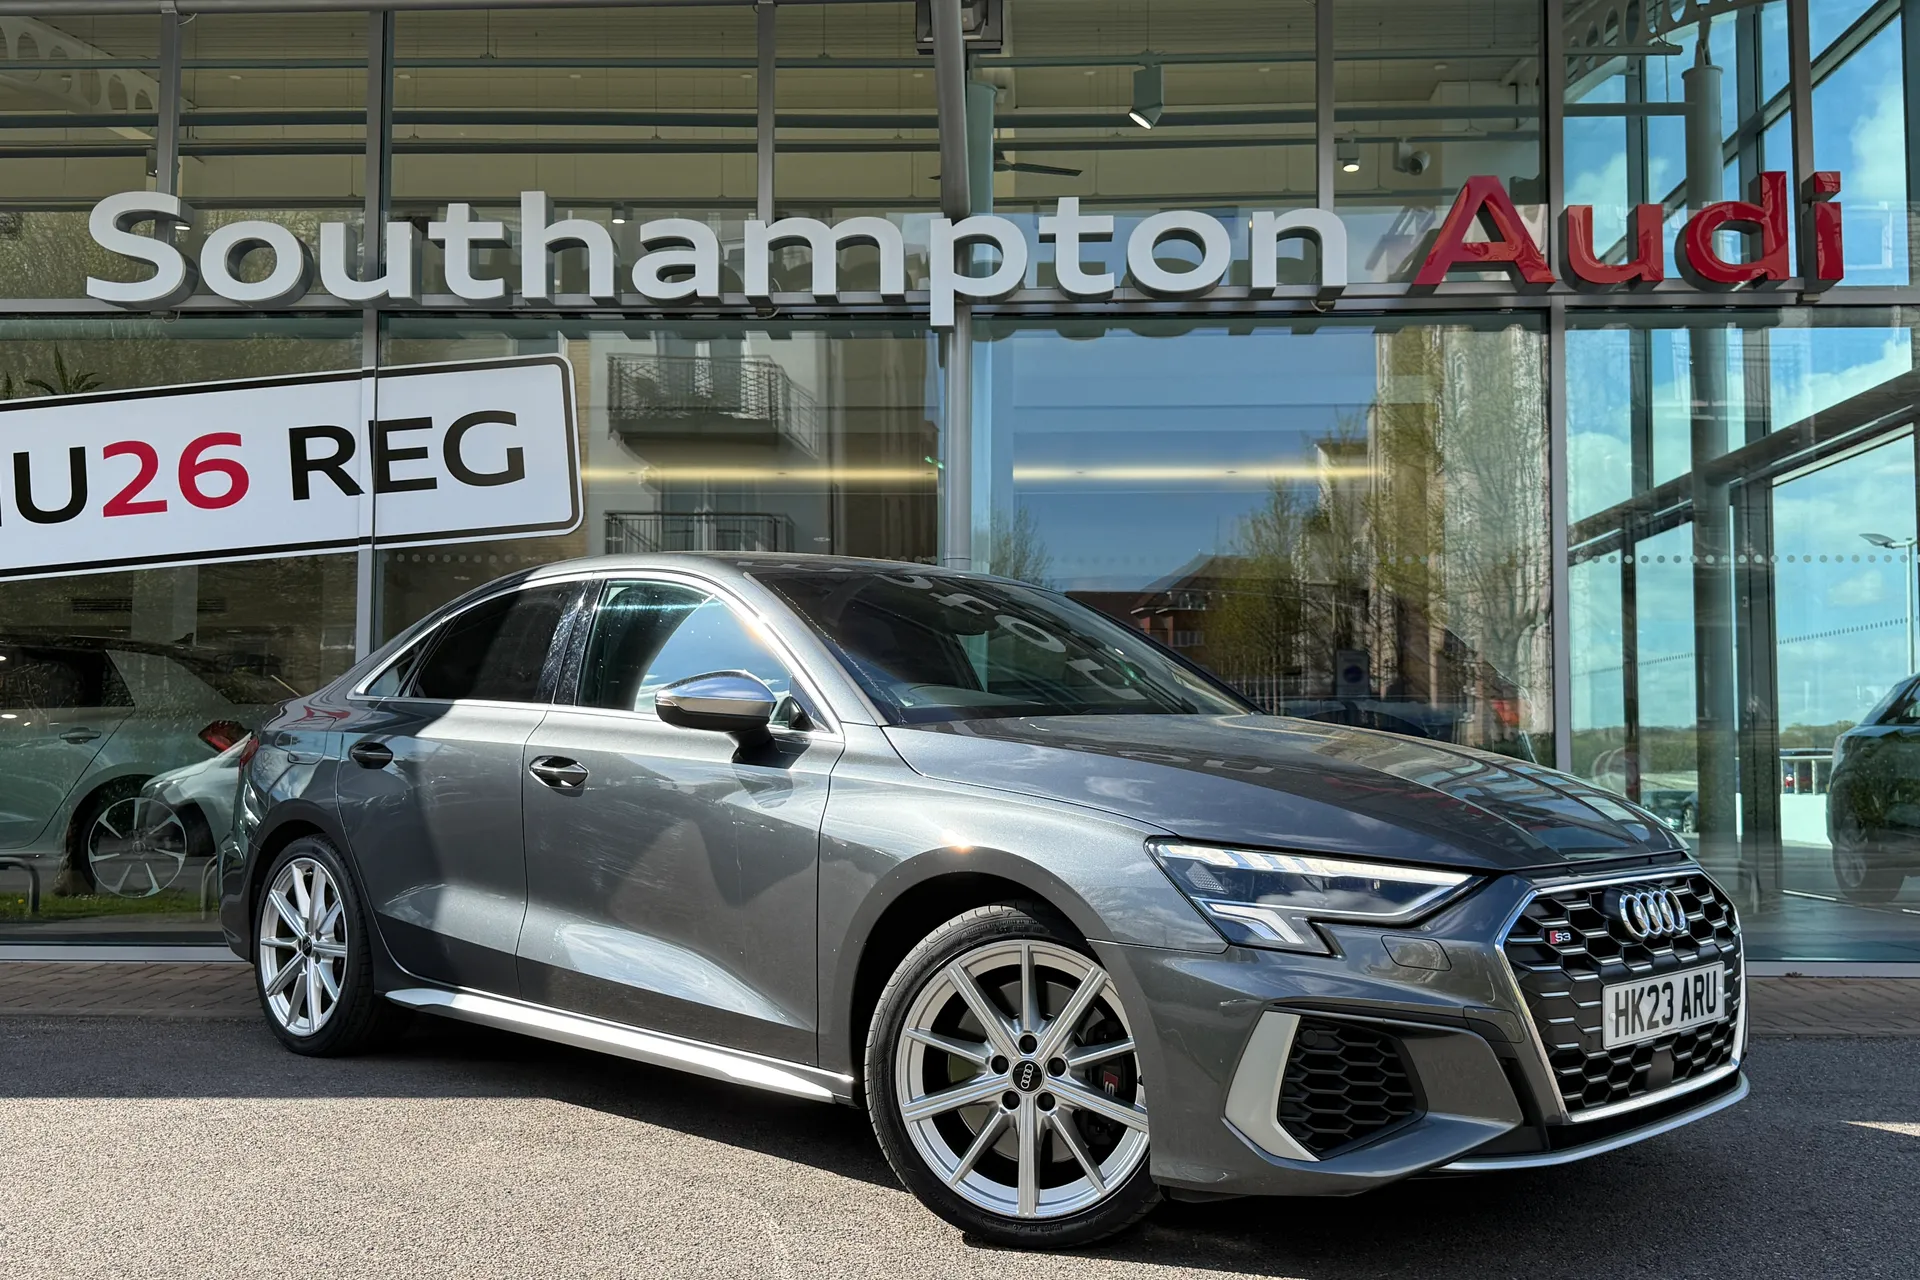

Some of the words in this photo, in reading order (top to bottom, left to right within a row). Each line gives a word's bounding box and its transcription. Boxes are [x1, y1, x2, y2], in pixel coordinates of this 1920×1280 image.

[86, 190, 1348, 328] Southampton
[1410, 171, 1845, 288] Audi
[0, 431, 250, 527] U26
[288, 410, 526, 501] REG
[1555, 932, 1571, 942] S3
[1614, 981, 1674, 1038] HK23
[1681, 970, 1717, 1022] ARU
